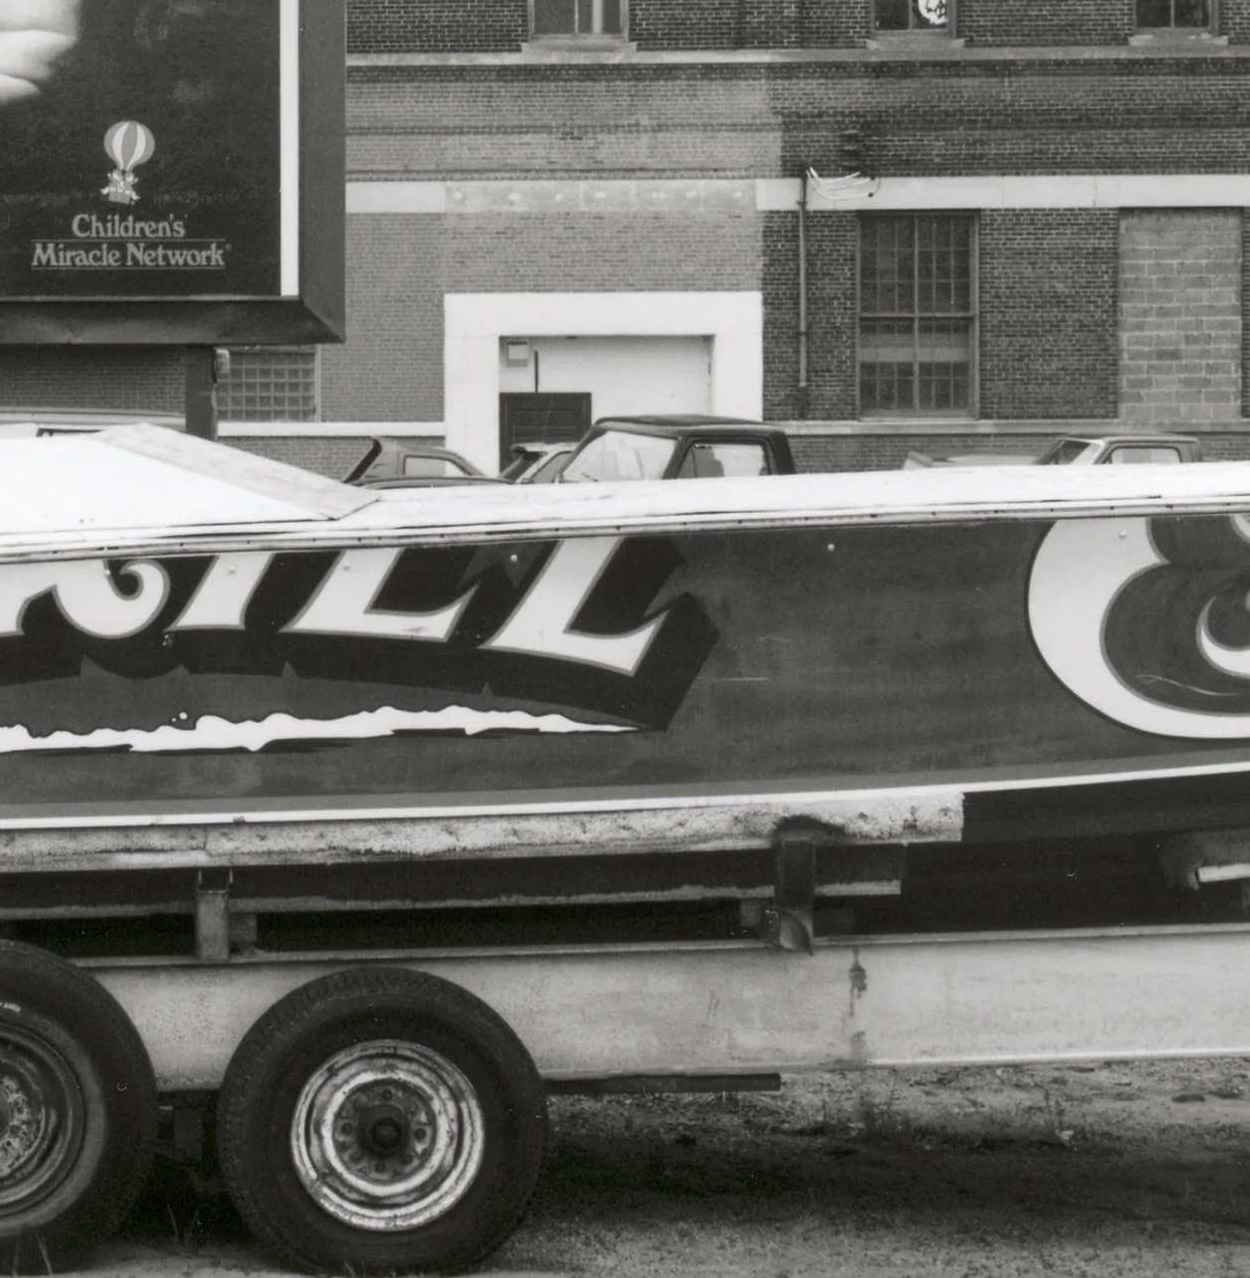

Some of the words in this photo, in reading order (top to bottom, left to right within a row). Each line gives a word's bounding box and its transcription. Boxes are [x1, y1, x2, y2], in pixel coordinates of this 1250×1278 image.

[71, 213, 186, 238] Children's
[31, 242, 121, 267] Miracle
[126, 242, 225, 267] Network
